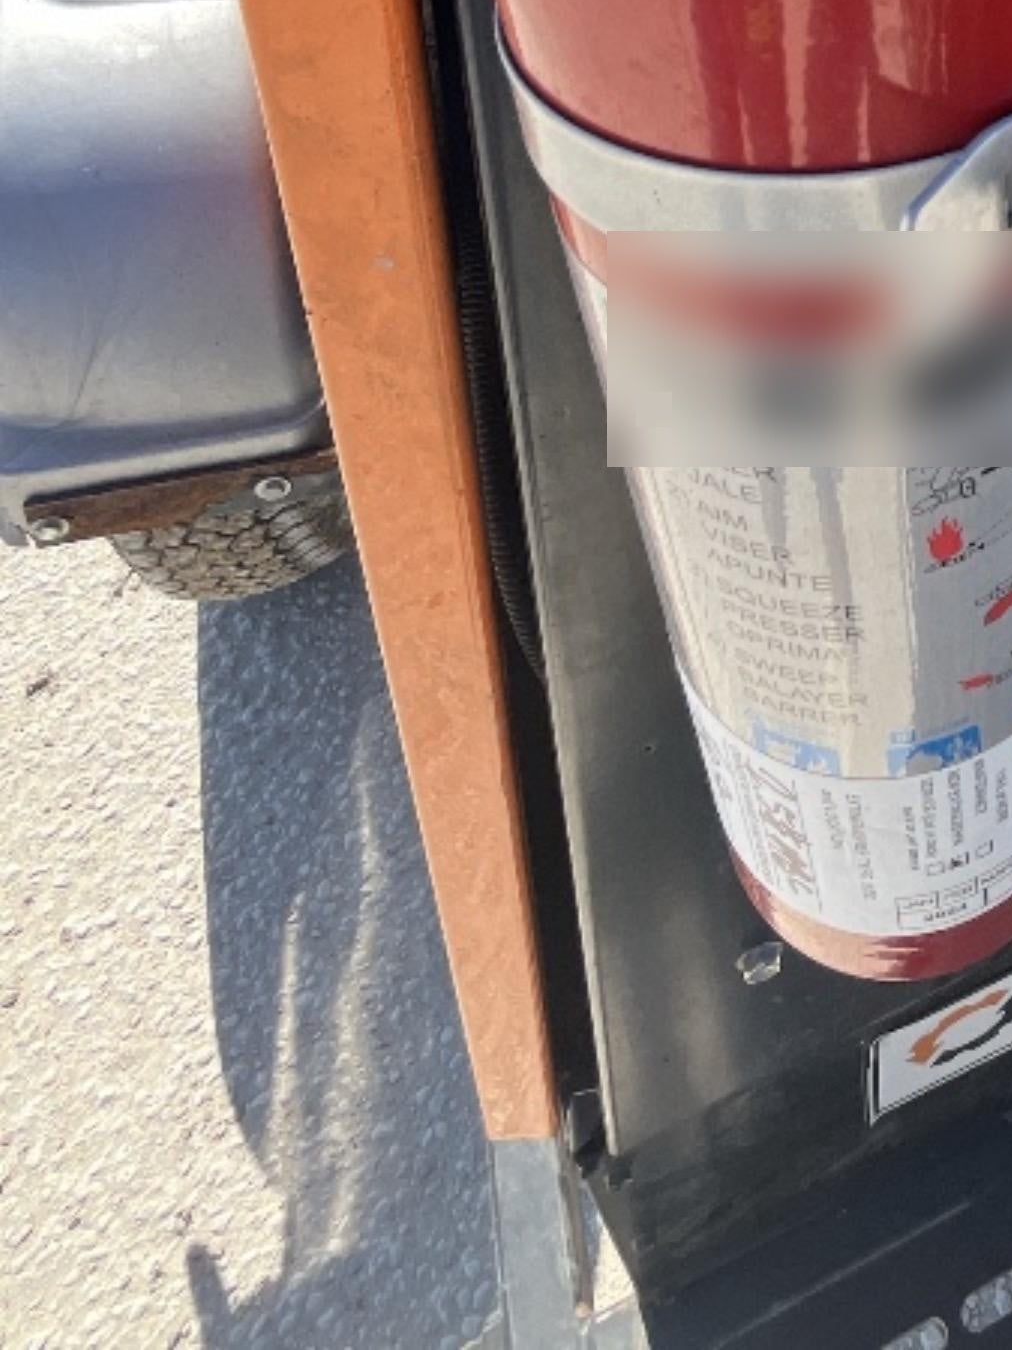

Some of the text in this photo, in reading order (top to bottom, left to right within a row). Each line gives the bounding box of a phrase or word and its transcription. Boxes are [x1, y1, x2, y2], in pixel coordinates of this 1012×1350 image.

[706, 548, 832, 592] APUNTE
[716, 576, 865, 622] SQUEEZE
[721, 600, 867, 644] PRESSER
